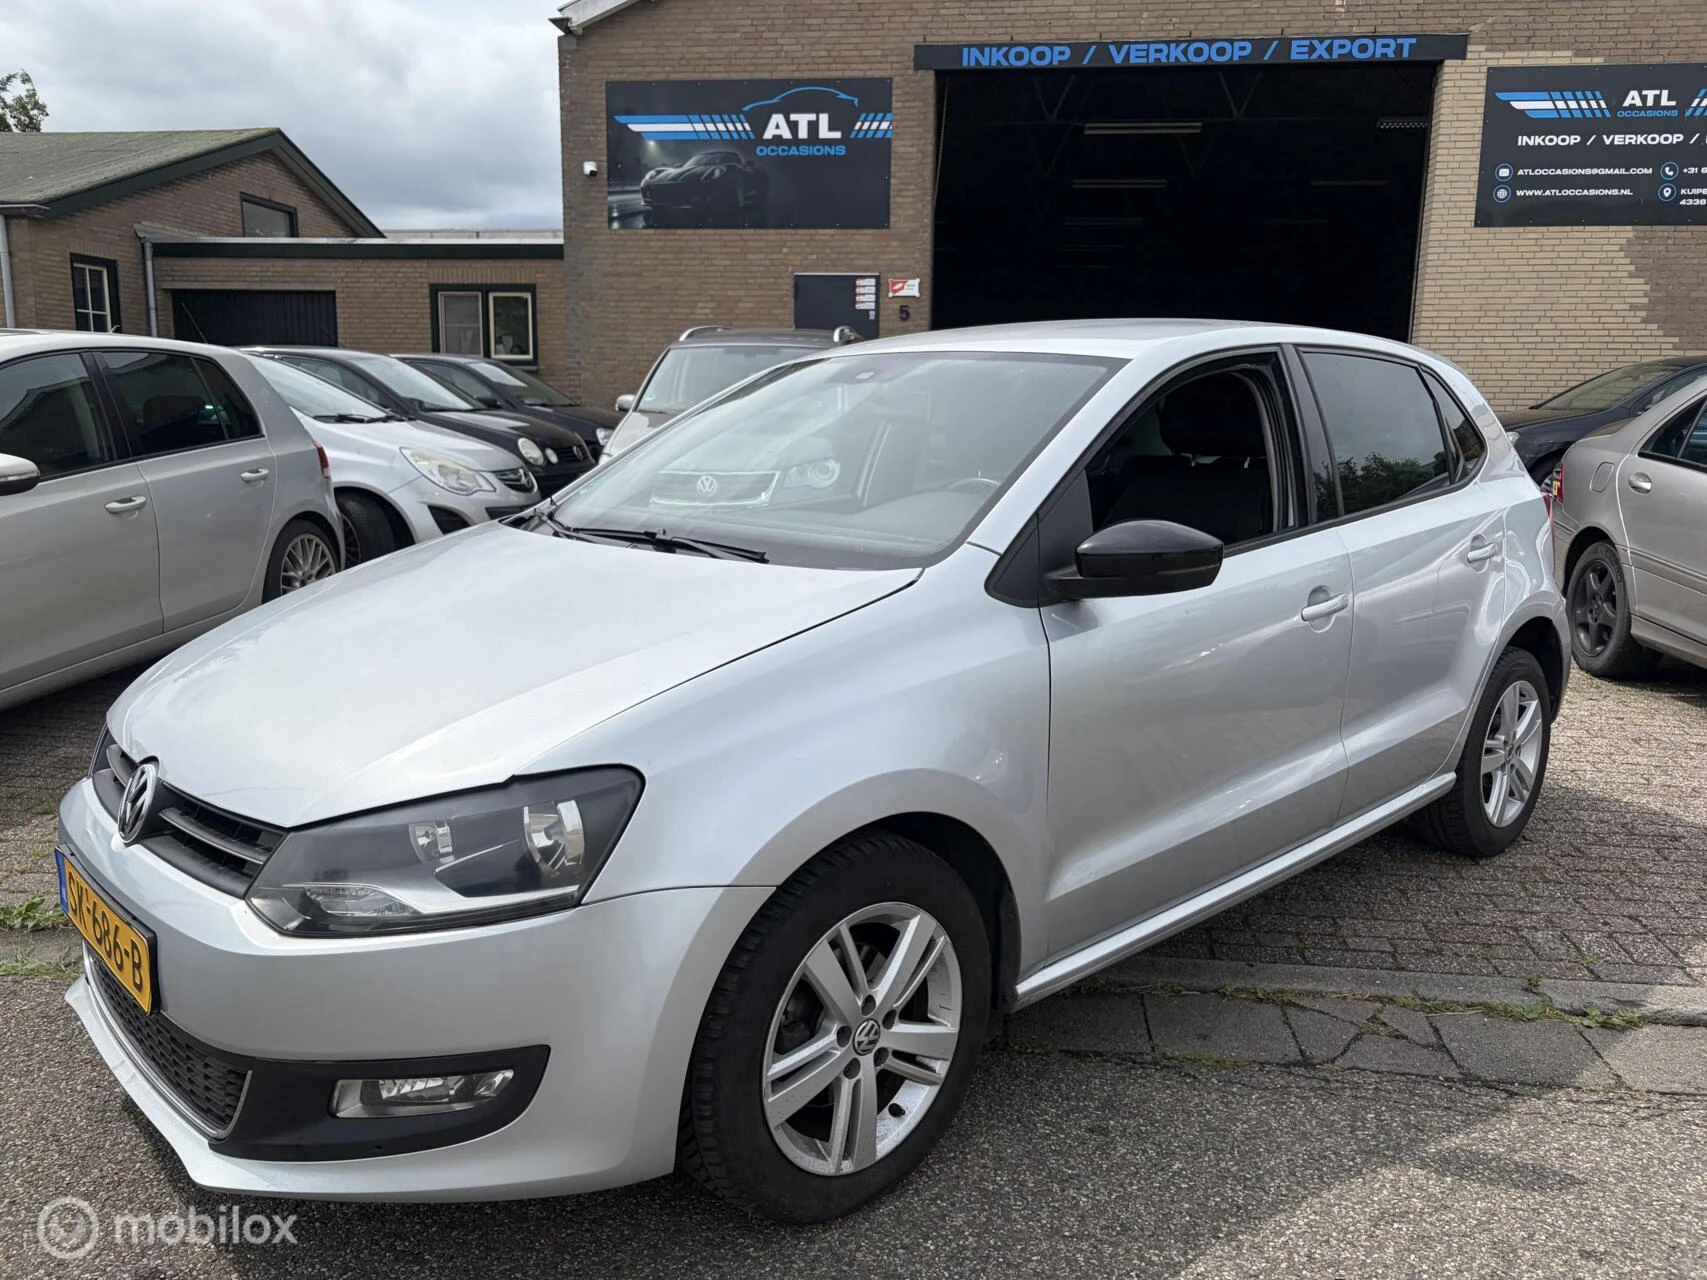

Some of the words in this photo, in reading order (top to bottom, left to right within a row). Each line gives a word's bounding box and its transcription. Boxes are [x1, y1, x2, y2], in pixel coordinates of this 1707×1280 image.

[962, 45, 1072, 67] INKOOP
[1082, 45, 1097, 65] /
[1108, 41, 1253, 64] VERKOOP
[1264, 40, 1279, 60] /
[1290, 38, 1416, 60] EXPORT
[1622, 89, 1677, 107] ATL
[1617, 109, 1679, 118] OCCASIONS
[762, 113, 842, 139] ATL
[1517, 135, 1582, 146] INKOOP
[1586, 134, 1597, 146] /
[1602, 133, 1684, 145] VERKOOP
[1689, 133, 1700, 144] /
[756, 145, 846, 156] OCCASIONS
[1517, 167, 1653, 176] ATLOCCASIONS@GMAIL.COM
[1516, 188, 1633, 197] WWW.ATLOCCASIONS.NL
[1680, 198, 1707, 206] 4338
[898, 304, 910, 321] 5
[68, 871, 143, 993] SK-686-B
